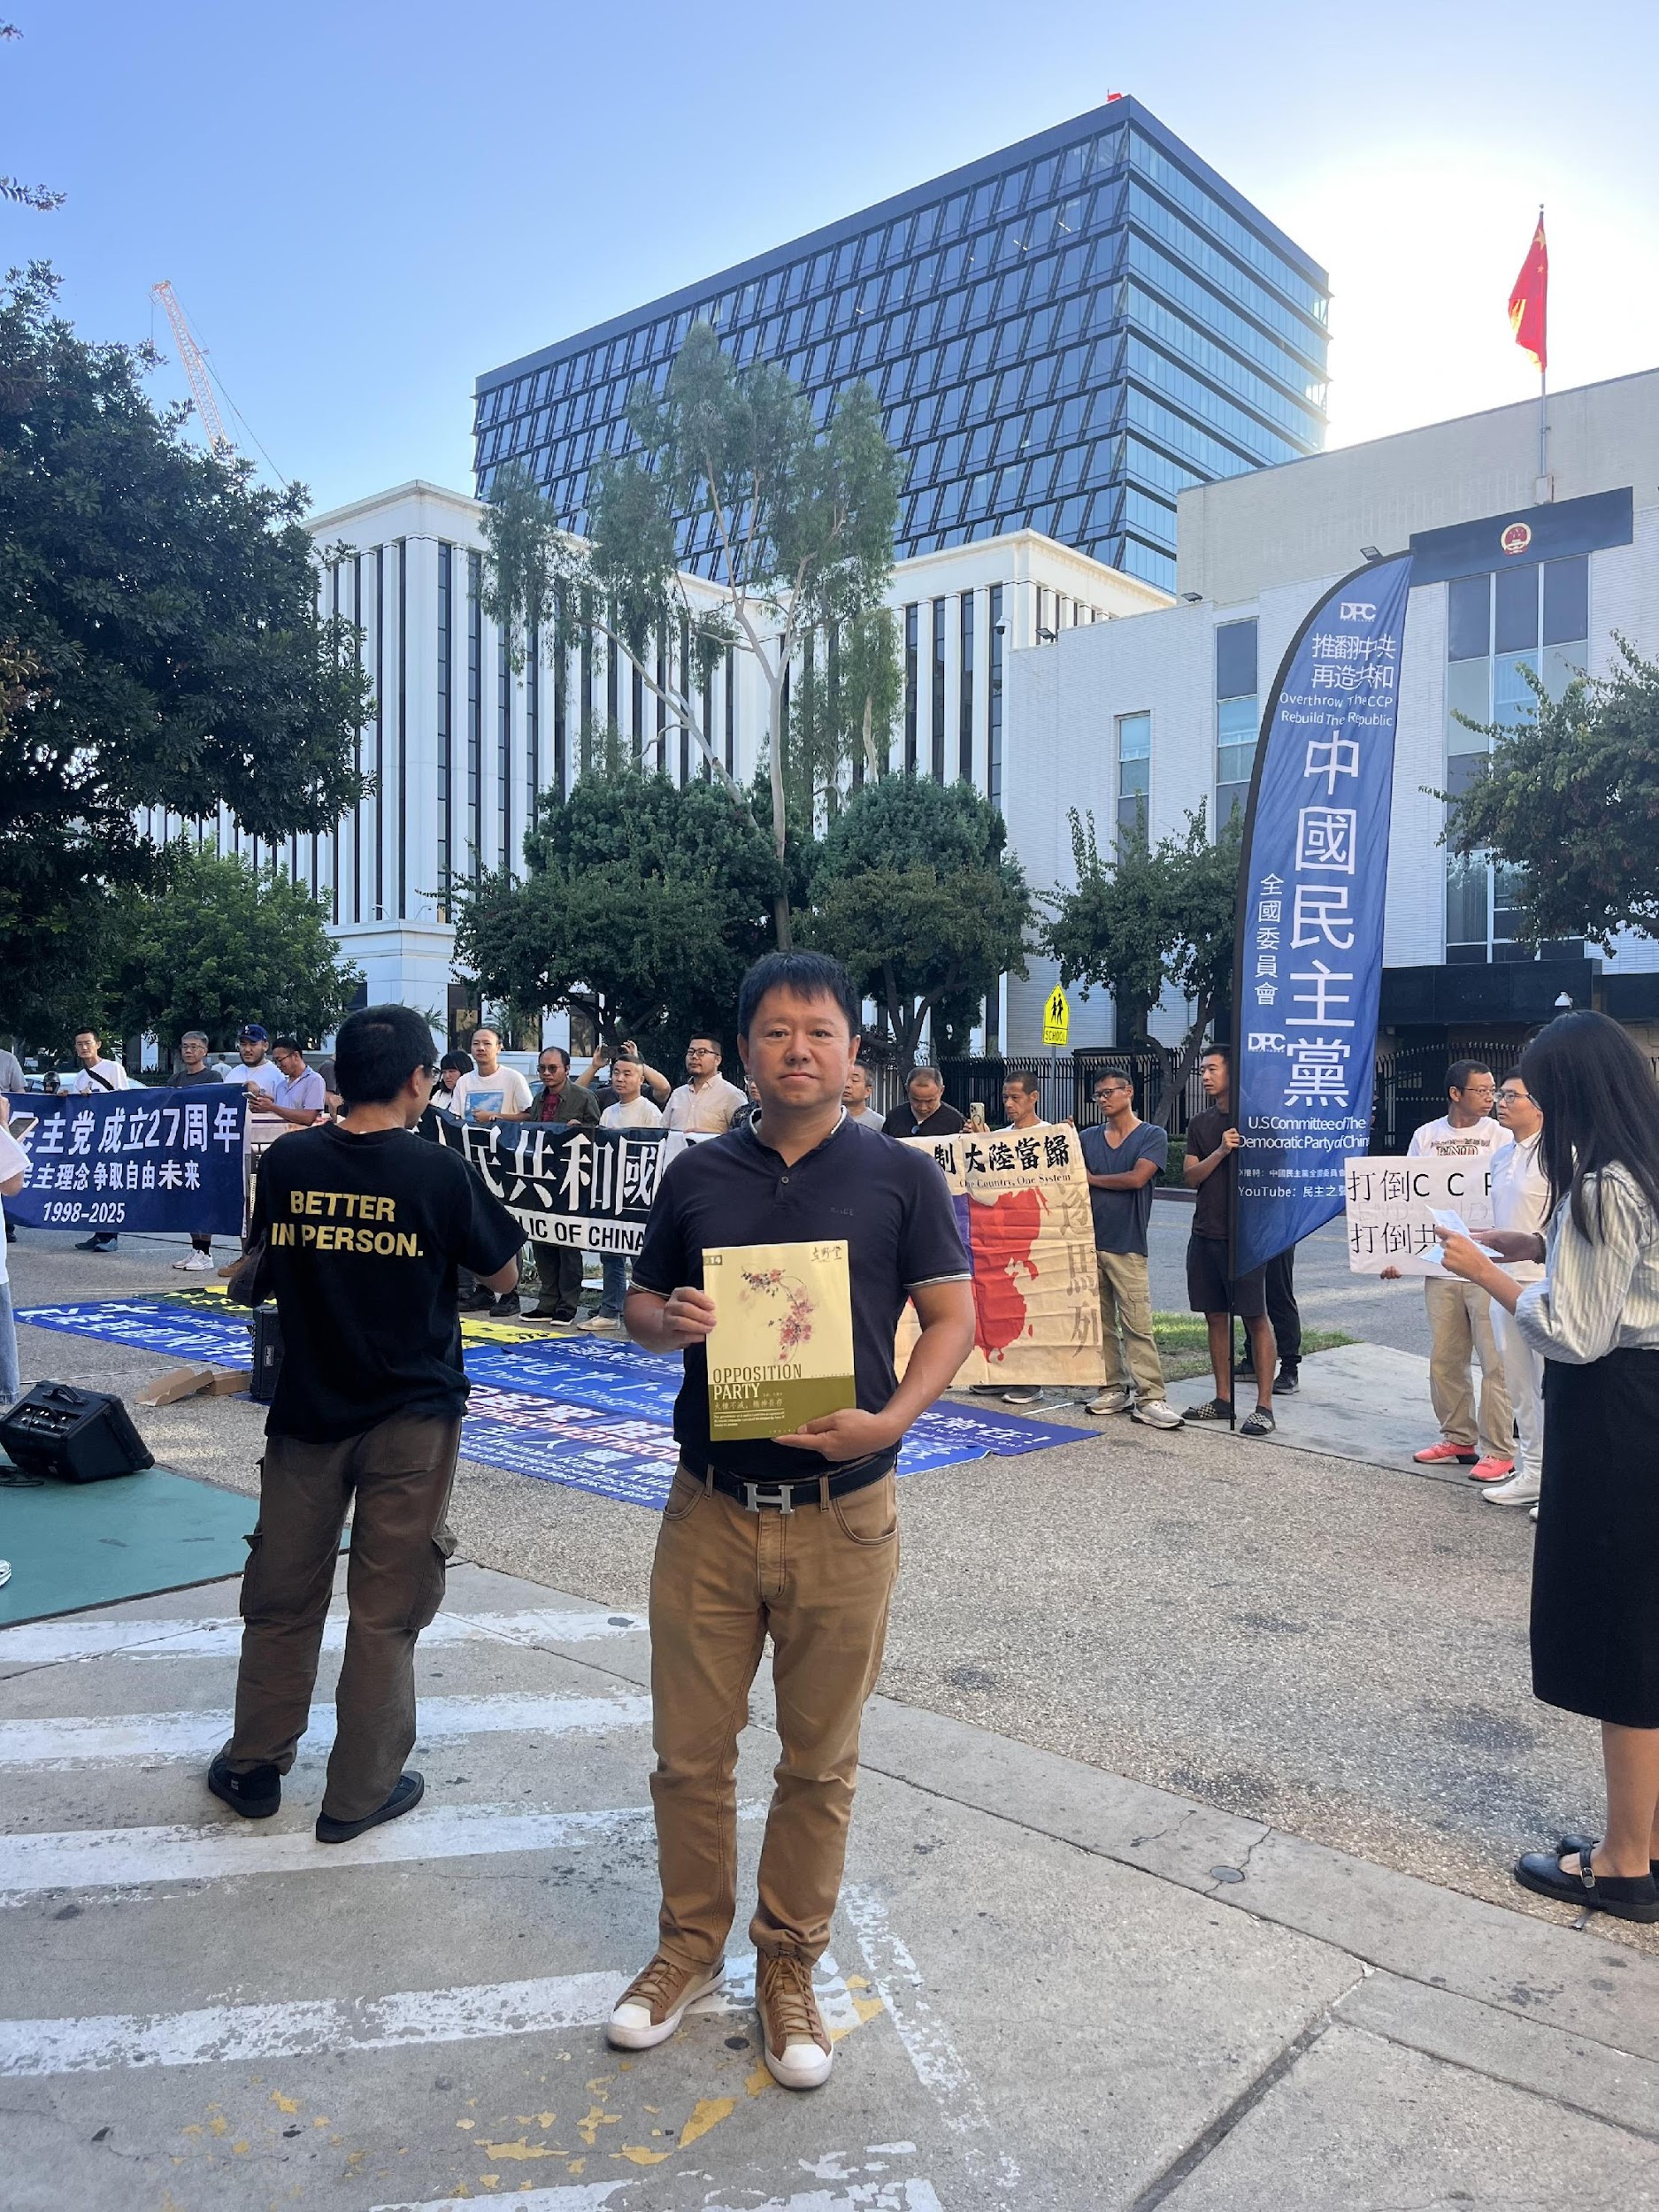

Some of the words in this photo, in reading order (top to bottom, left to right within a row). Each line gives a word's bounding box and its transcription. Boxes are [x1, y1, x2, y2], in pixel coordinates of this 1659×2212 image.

[1311, 633, 1396, 661] 推翻中共
[1311, 663, 1394, 691] 再造共和
[1279, 692, 1343, 708] Overthrow
[1367, 695, 1394, 708] CCP
[1281, 710, 1324, 724] Rebuild
[1326, 713, 1345, 726] The
[1348, 711, 1393, 726] Republic
[1283, 729, 1359, 1108] 中國民主黨
[1254, 872, 1285, 1007] 全國委員會
[1045, 1030, 1066, 1042] SCHOOL
[97, 1102, 241, 1154] 成立27周年
[1248, 1116, 1270, 1130] U.S
[1270, 1117, 1335, 1131] Committee
[965, 1134, 1071, 1174] 大陸當歸
[1238, 1135, 1304, 1148] Democratic
[1304, 1136, 1335, 1153] Party
[93, 1158, 201, 1191] 争取自由未来
[435, 1115, 665, 1216] 民共和國
[1018, 1176, 1034, 1185] One
[1039, 1174, 1071, 1187] System
[43, 1201, 126, 1224] 1998-2025
[290, 1190, 396, 1223] BETTER
[271, 1223, 296, 1247] IN
[301, 1224, 424, 1257] PERSON.
[555, 1222, 581, 1243] OF
[588, 1226, 645, 1251] CHINA
[712, 1363, 803, 1384] OPPOSITION
[713, 1383, 761, 1401] PARTY
